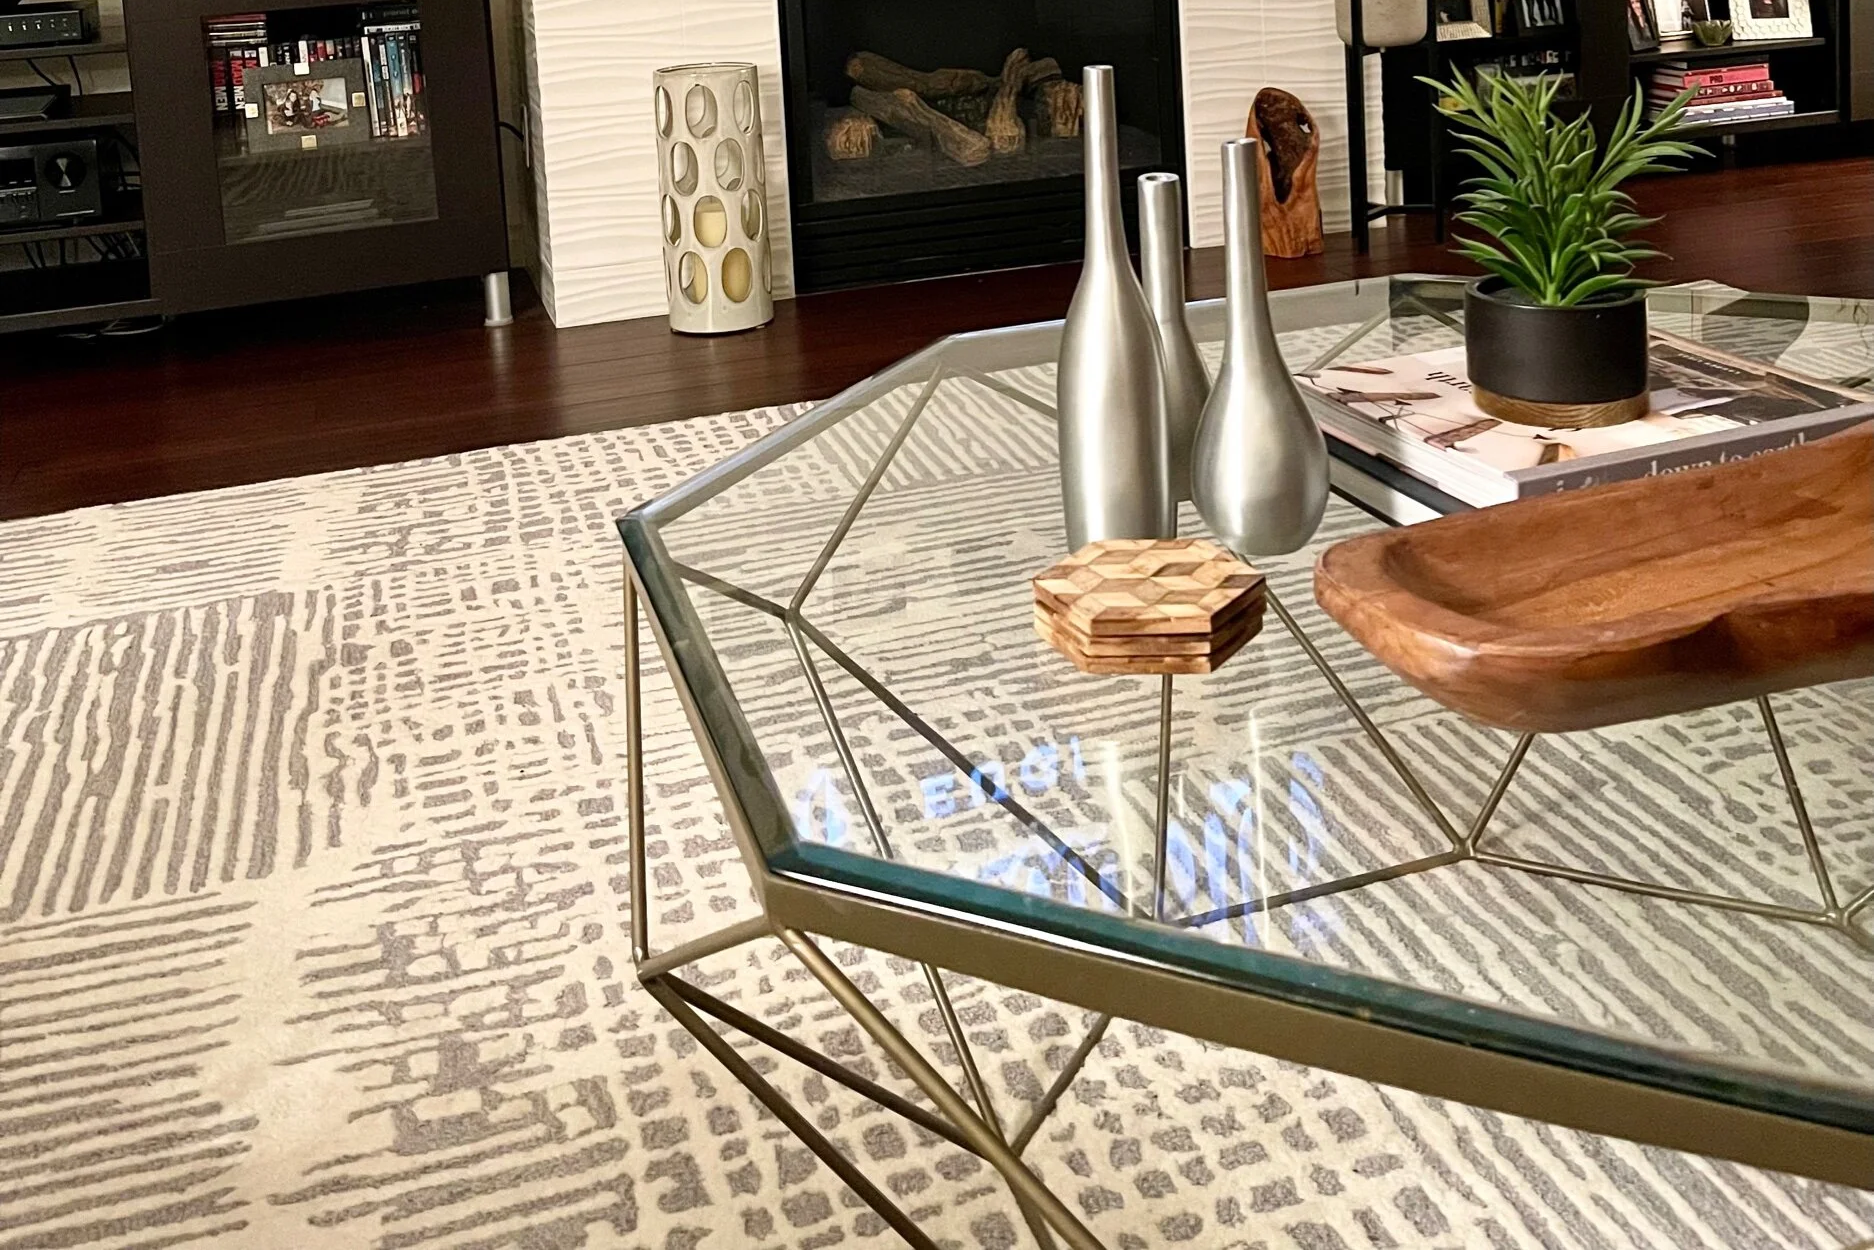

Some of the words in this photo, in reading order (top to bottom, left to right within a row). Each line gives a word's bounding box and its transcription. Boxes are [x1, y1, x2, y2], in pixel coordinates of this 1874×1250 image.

[214, 85, 228, 111] MEN
[233, 85, 246, 110] MEN
[1425, 371, 1472, 394] arth
